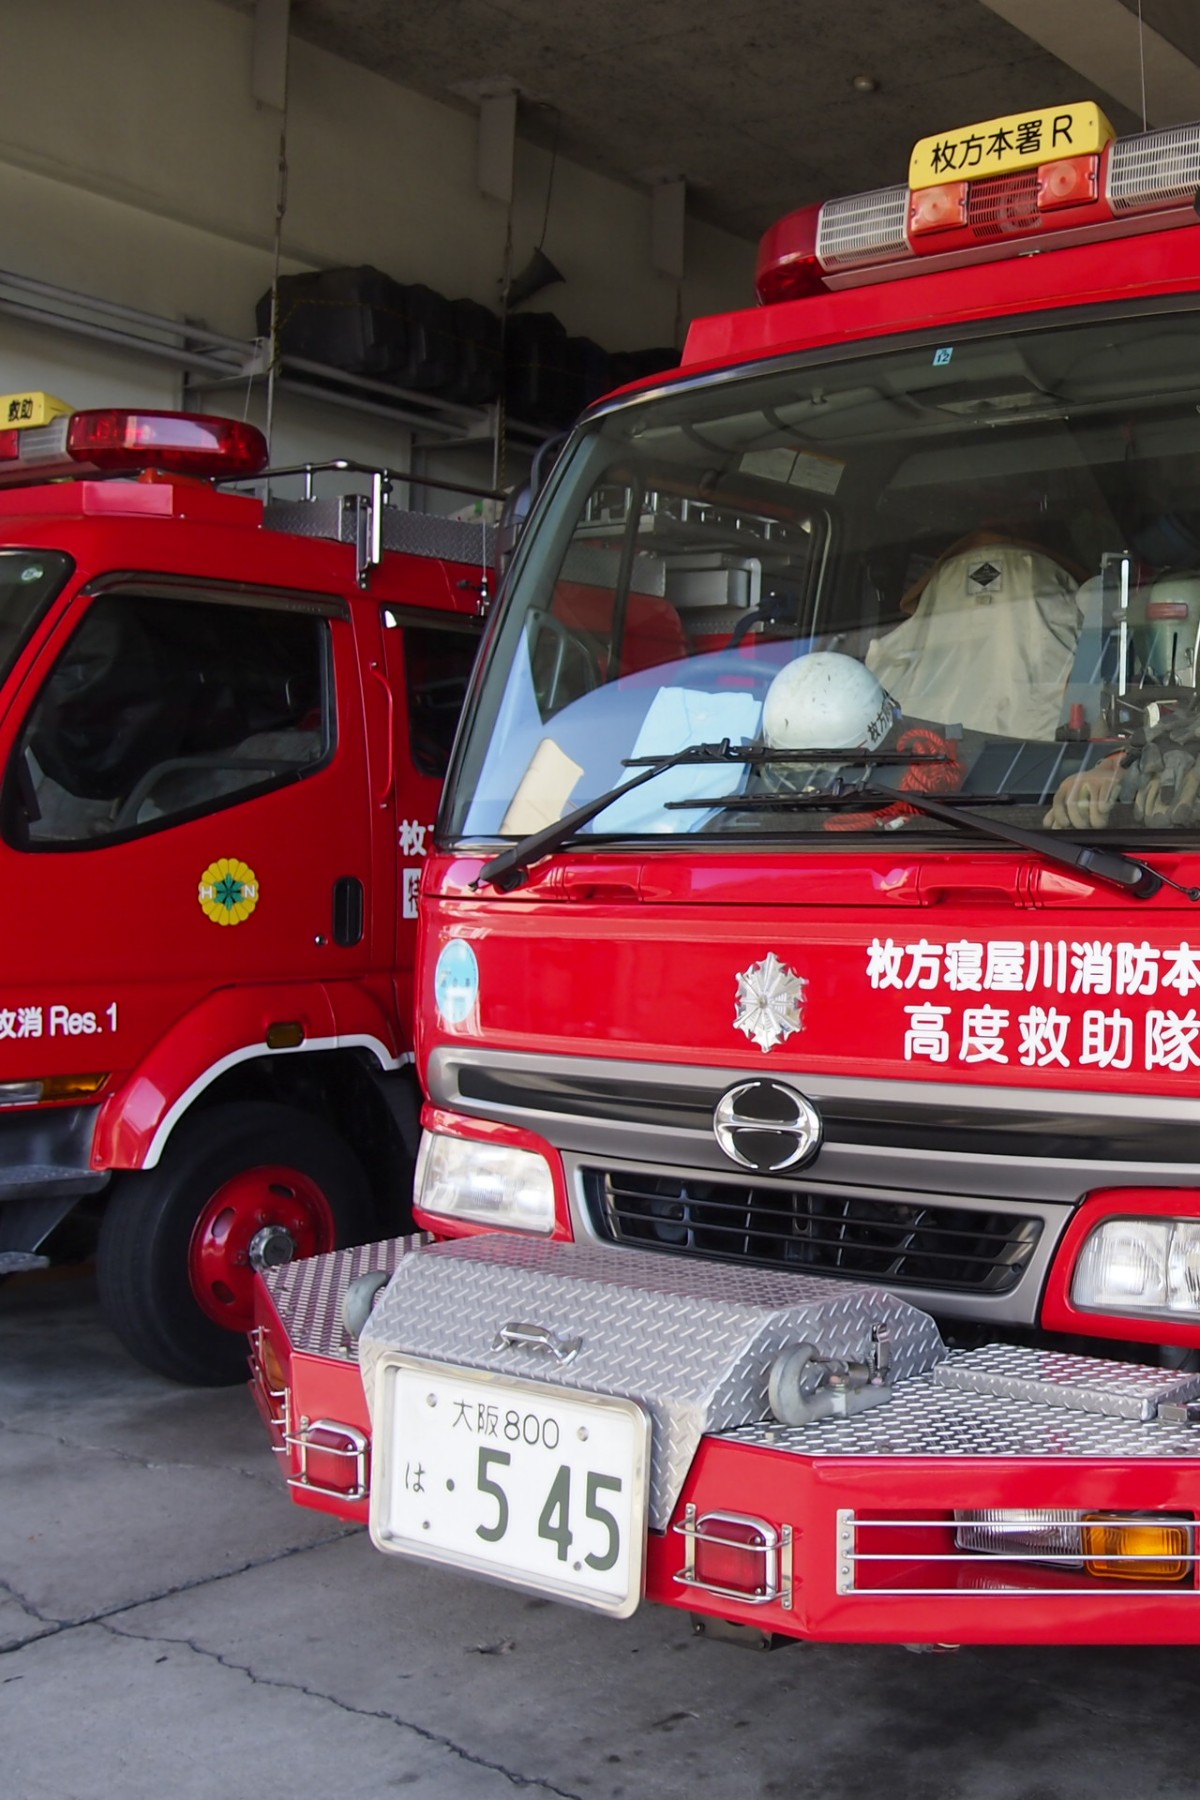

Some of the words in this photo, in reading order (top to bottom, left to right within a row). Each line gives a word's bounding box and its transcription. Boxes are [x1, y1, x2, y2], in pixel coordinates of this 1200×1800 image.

[8, 398, 34, 422] 救助
[399, 819, 434, 856] 枚
[201, 885, 213, 899] H
[244, 884, 256, 898] N
[405, 1461, 426, 1493] は
